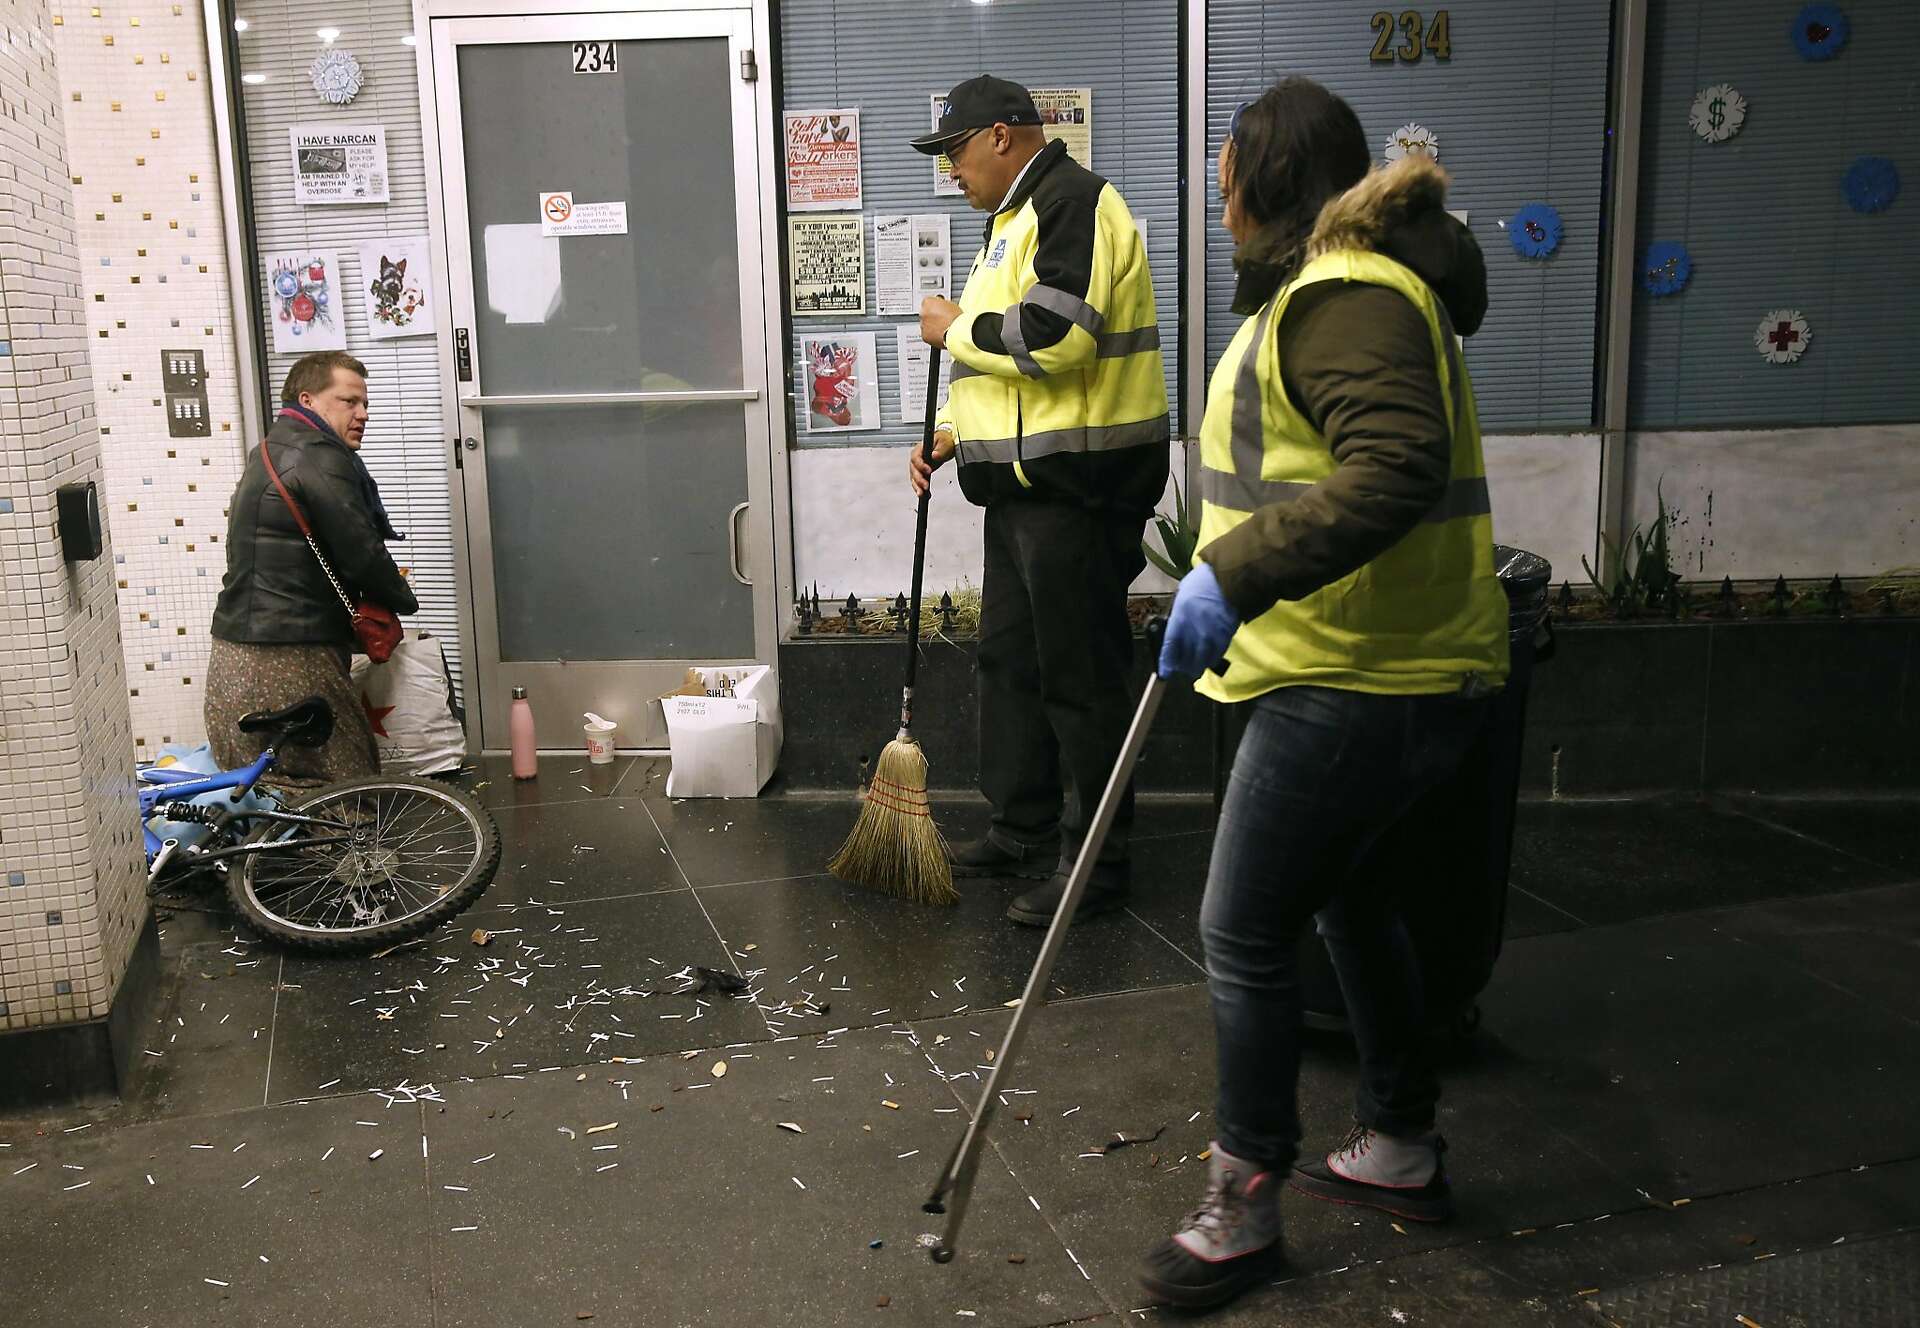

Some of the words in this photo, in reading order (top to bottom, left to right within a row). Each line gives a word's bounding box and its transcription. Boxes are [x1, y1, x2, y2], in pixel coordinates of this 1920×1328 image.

[1370, 10, 1450, 61] 234
[574, 42, 615, 72] 234
[297, 136, 301, 145] I
[303, 136, 330, 145] HAVE
[333, 134, 376, 144] NARCAN
[457, 329, 470, 369] PULL
[707, 689, 727, 698] THIS
